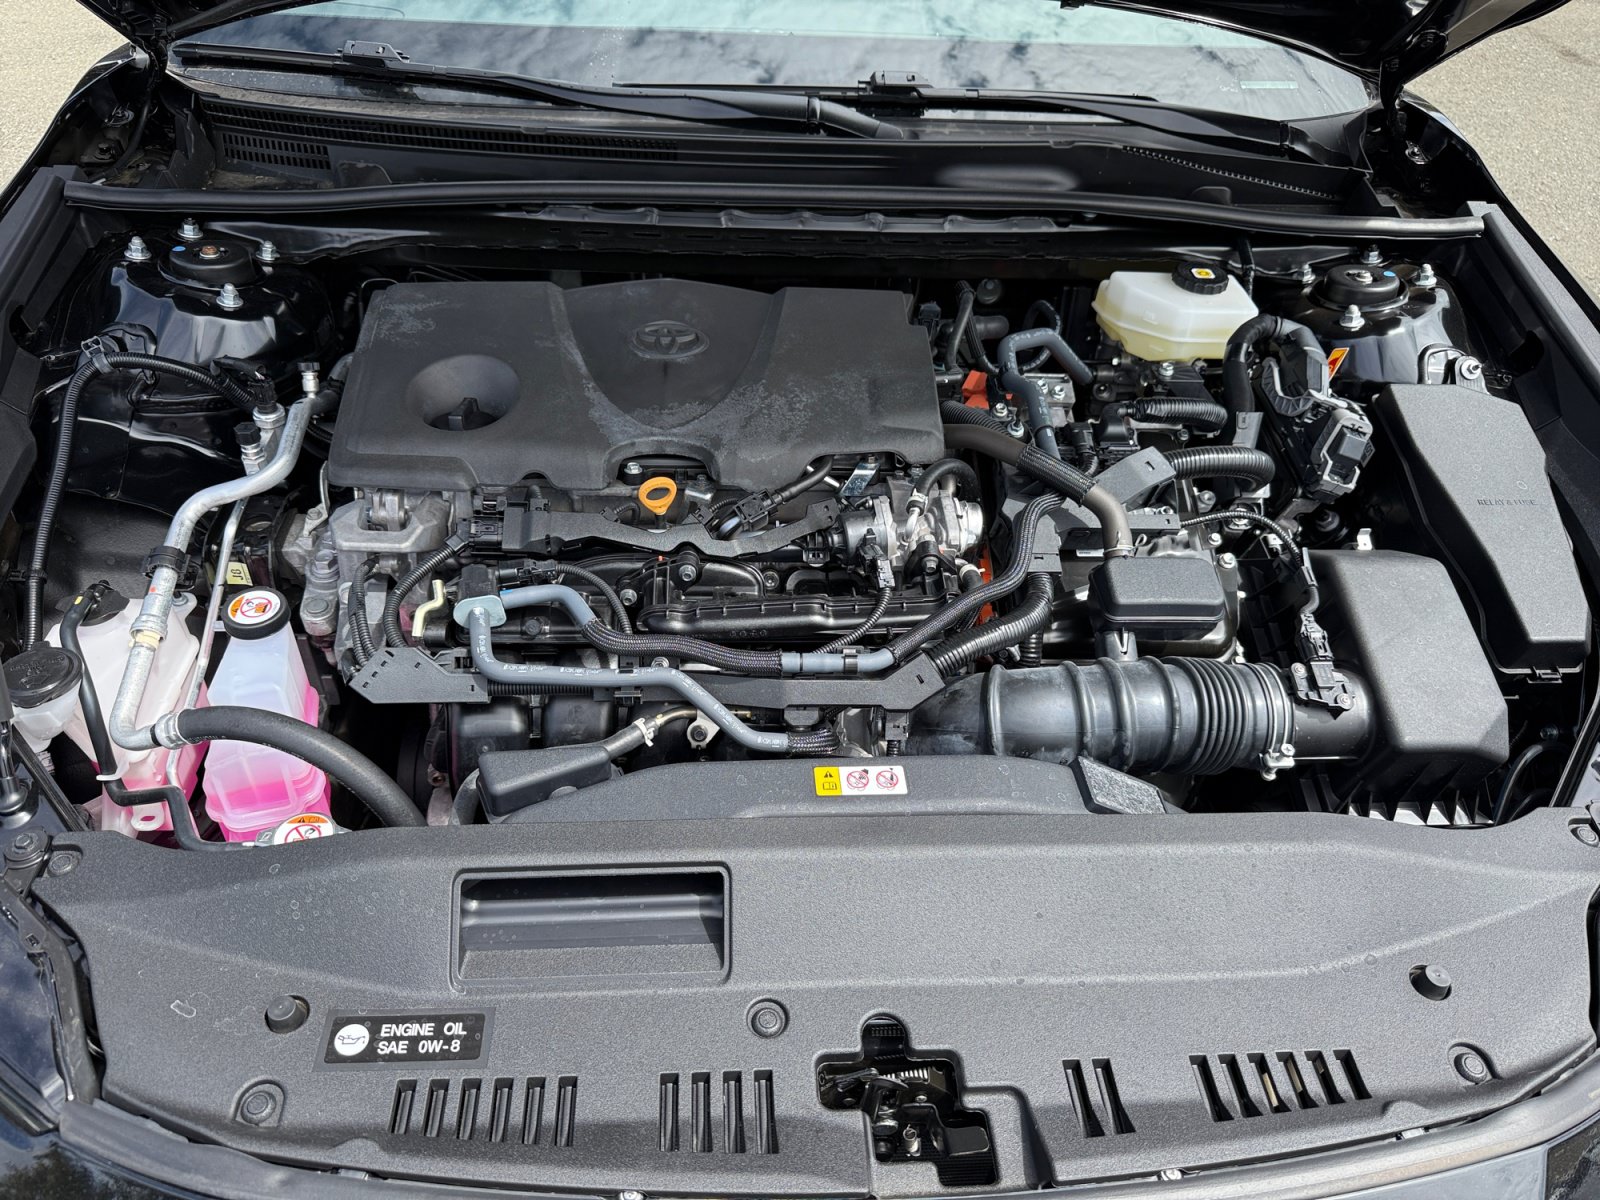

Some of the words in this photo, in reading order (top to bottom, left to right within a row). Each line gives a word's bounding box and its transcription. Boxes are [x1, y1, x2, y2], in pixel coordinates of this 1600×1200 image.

[1476, 498, 1504, 506] RELAY
[380, 1022, 435, 1037] ENGINE
[443, 1021, 467, 1036] OIL
[376, 1040, 409, 1054] SAE
[418, 1039, 461, 1054] 0W-8
